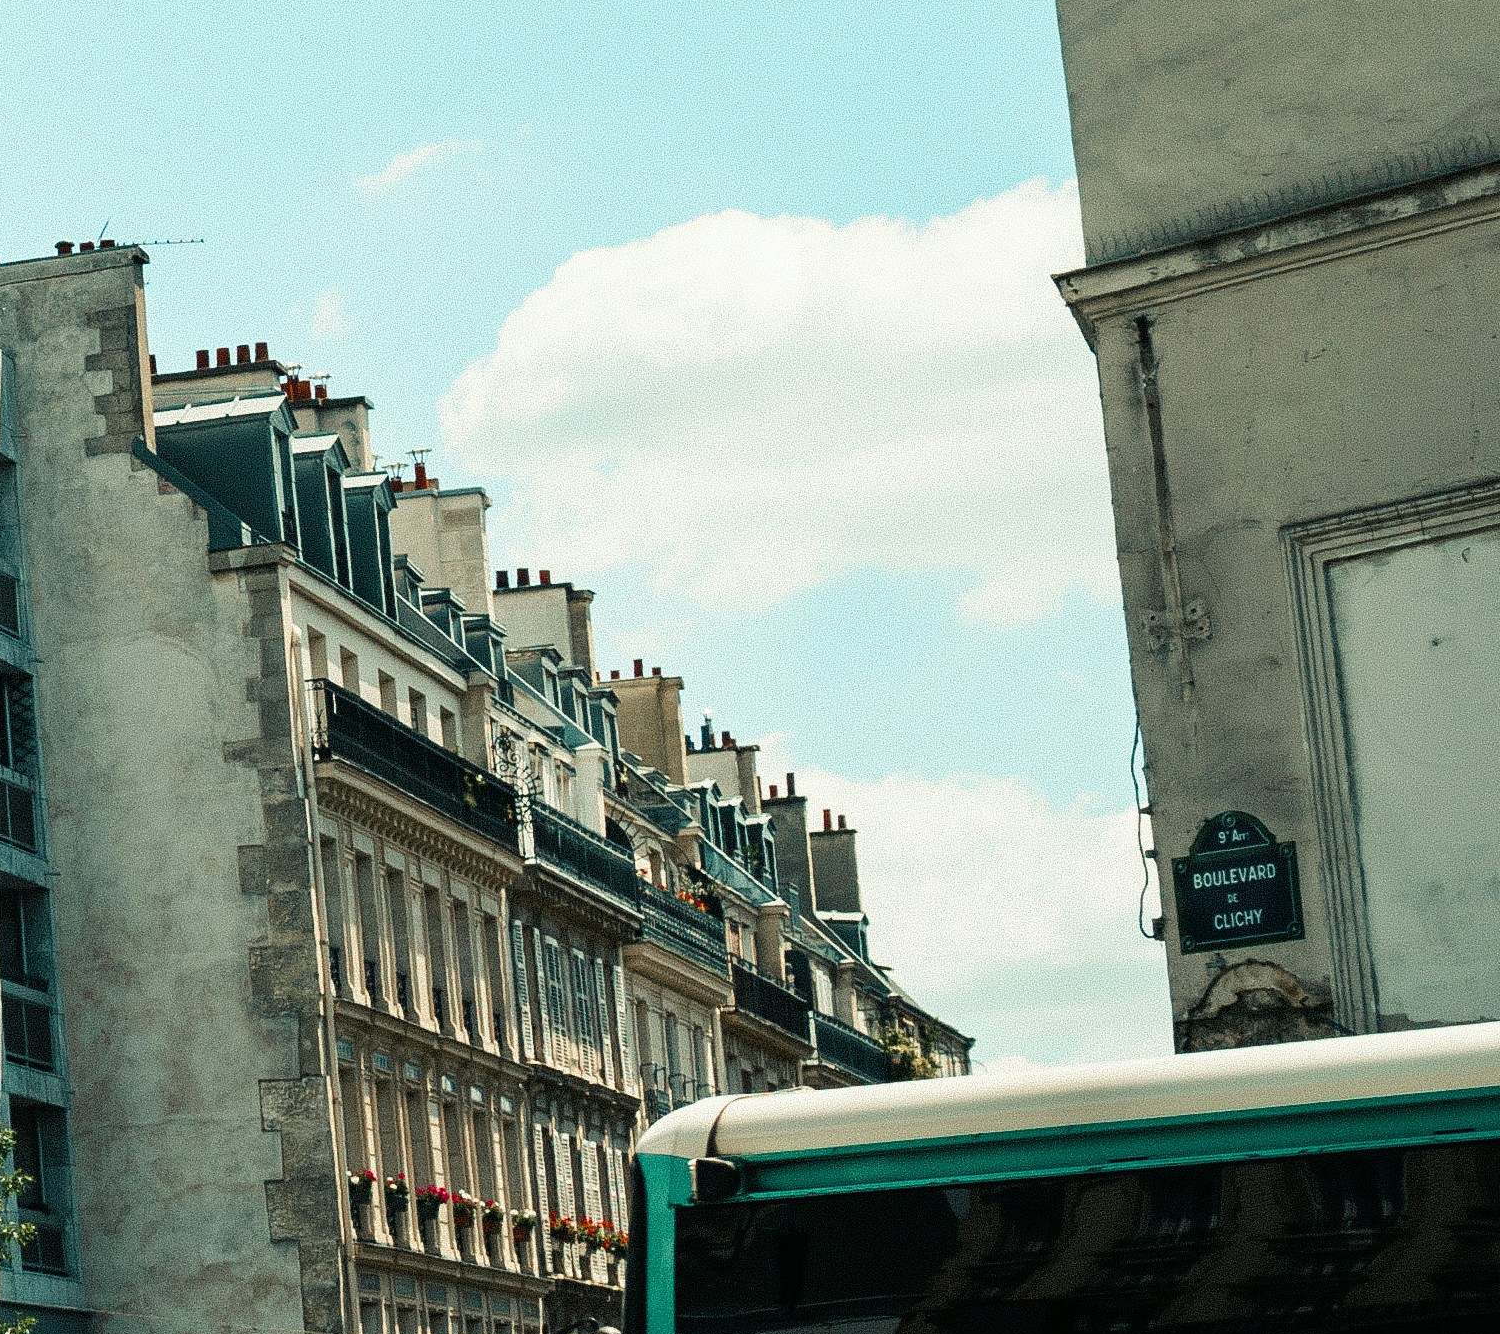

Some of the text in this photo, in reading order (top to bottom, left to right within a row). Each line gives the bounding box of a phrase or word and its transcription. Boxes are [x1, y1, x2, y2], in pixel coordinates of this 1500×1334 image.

[1193, 864, 1276, 889] BOULEVARD
[1228, 893, 1238, 903] DE
[1213, 908, 1263, 930] CLICHY
